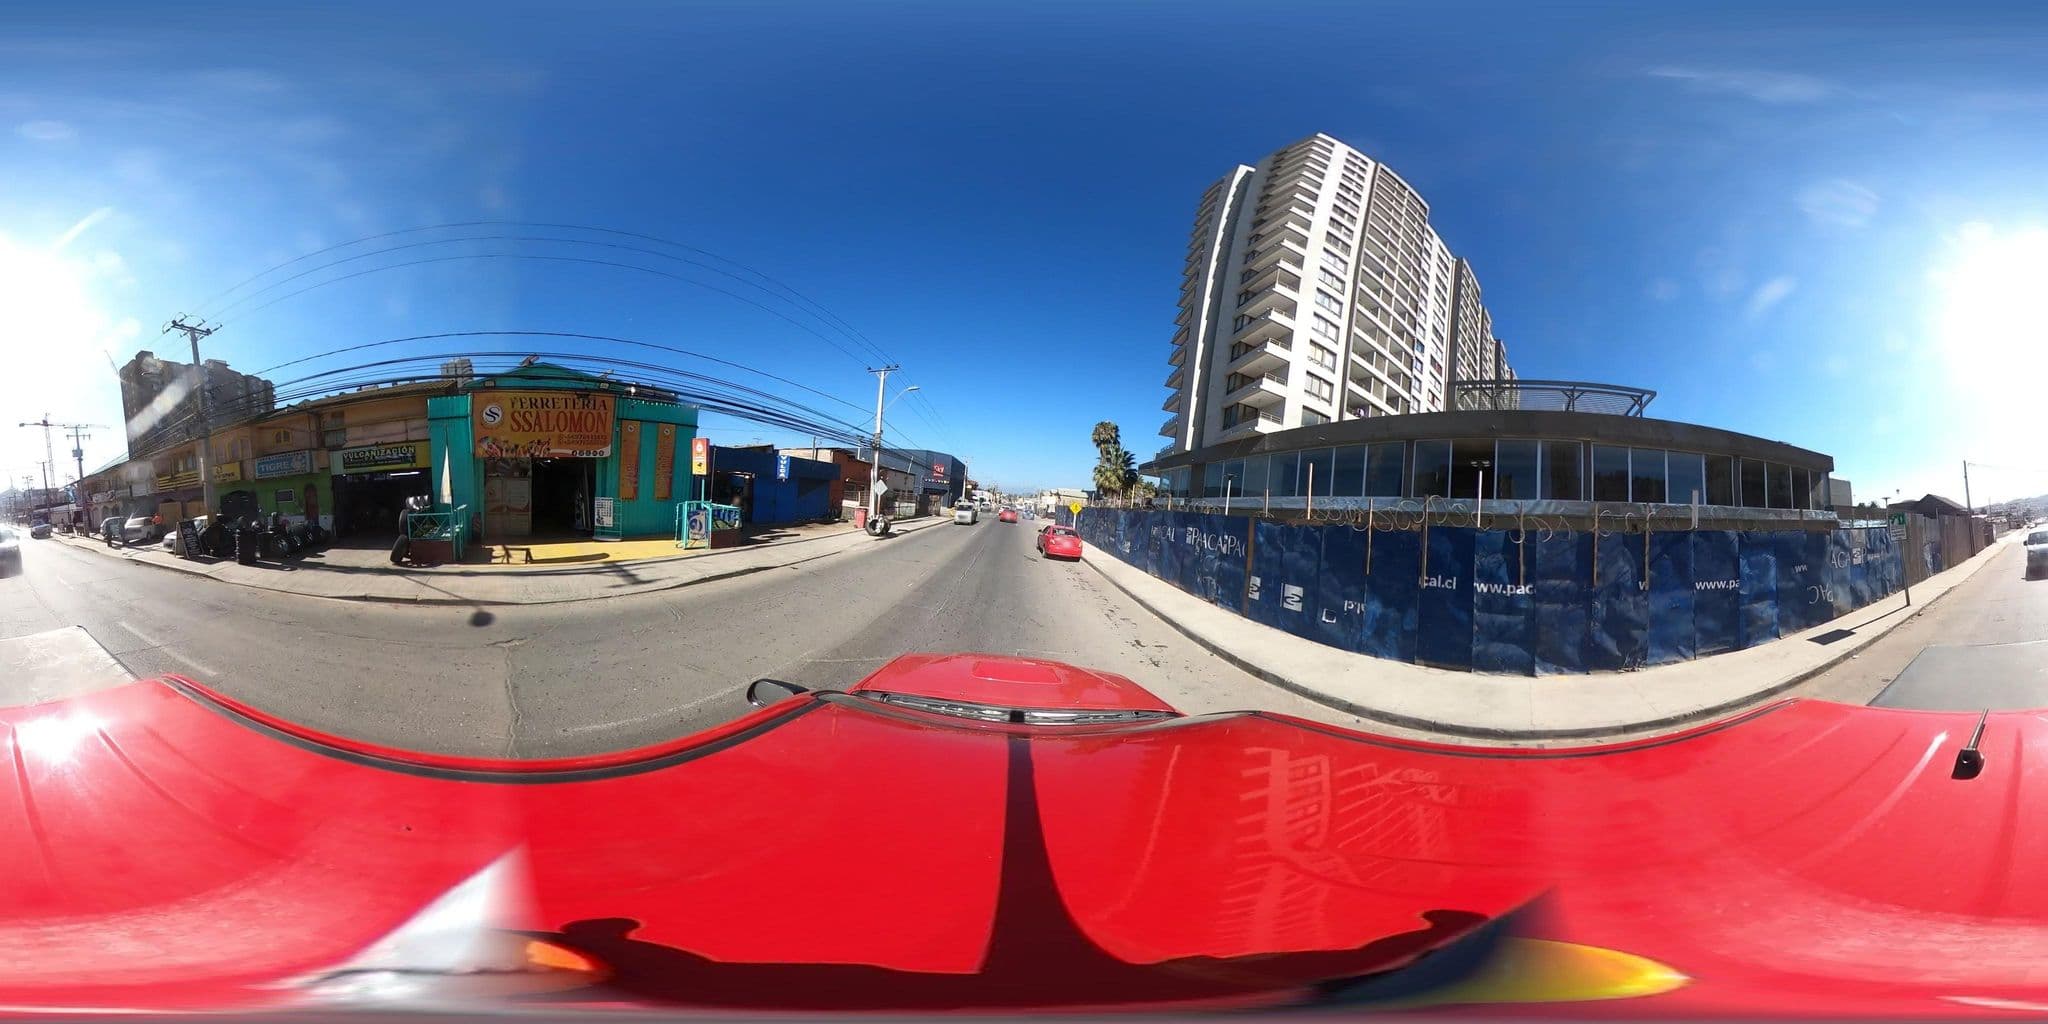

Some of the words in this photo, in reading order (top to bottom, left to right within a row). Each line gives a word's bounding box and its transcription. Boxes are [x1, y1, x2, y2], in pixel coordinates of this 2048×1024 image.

[259, 461, 289, 472] TIGRE
[1418, 574, 1457, 590] cal.cl
[1473, 582, 1536, 597] ww.pac
